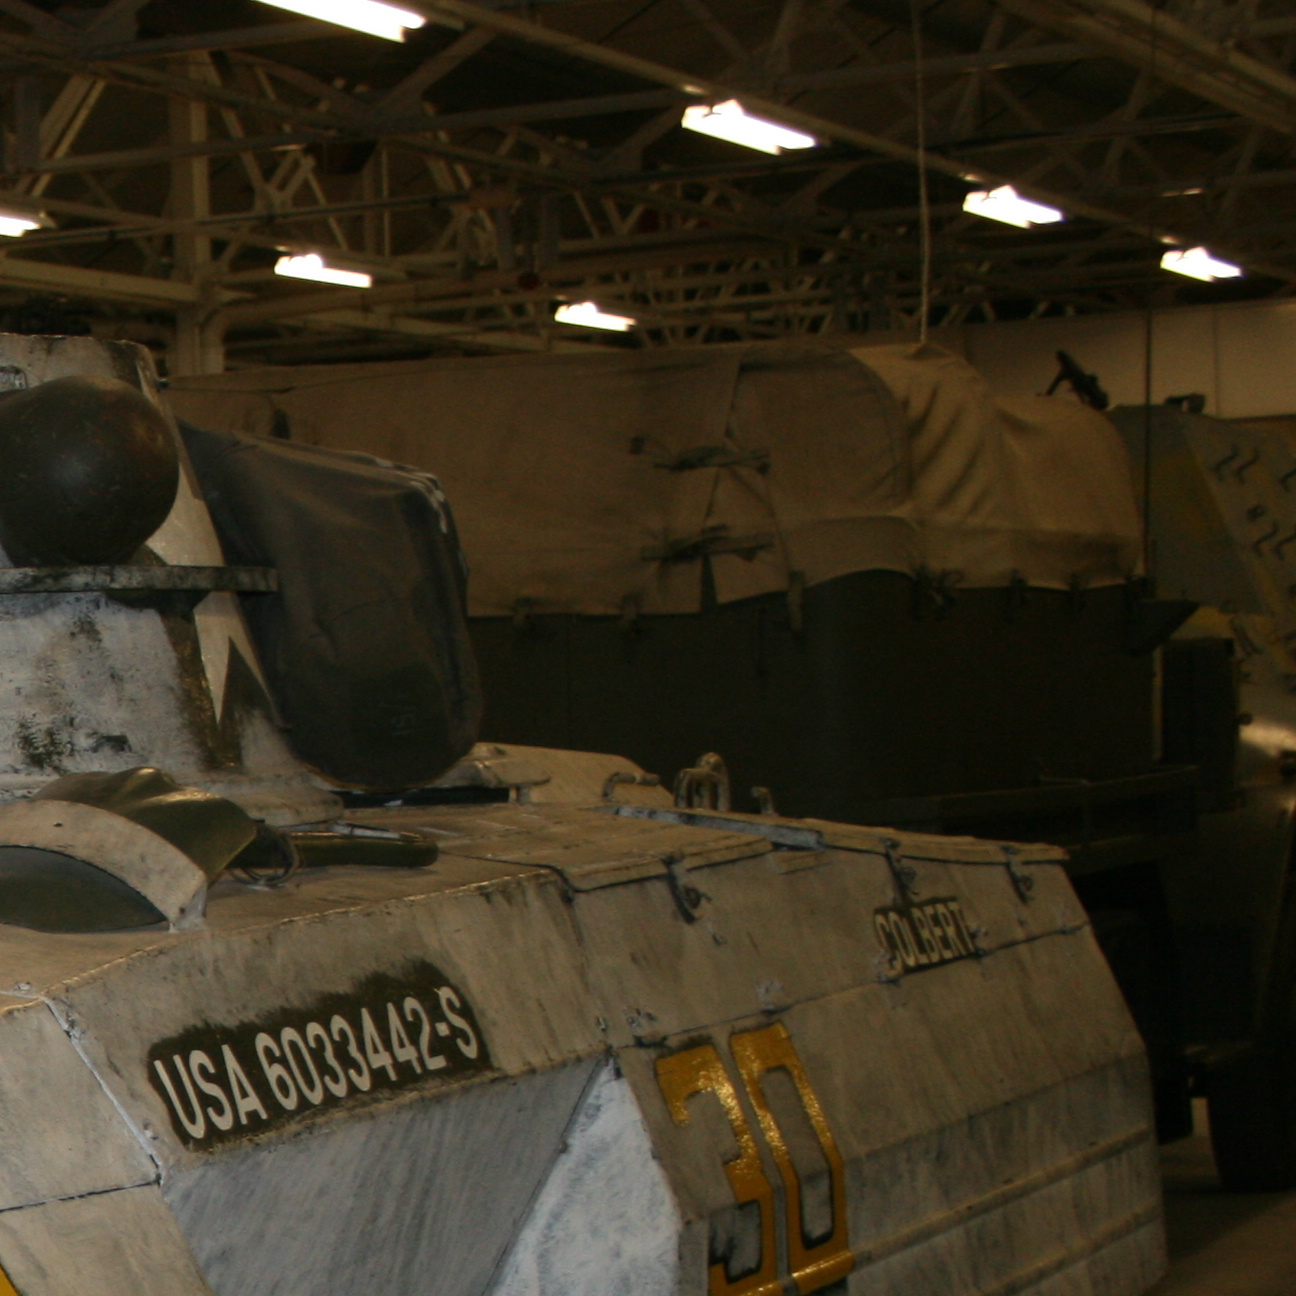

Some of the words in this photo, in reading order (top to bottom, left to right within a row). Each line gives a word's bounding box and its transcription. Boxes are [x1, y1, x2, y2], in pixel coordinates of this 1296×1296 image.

[874, 901, 976, 975] COLBERT
[153, 1043, 268, 1139] USA
[254, 986, 479, 1111] 6033442-S
